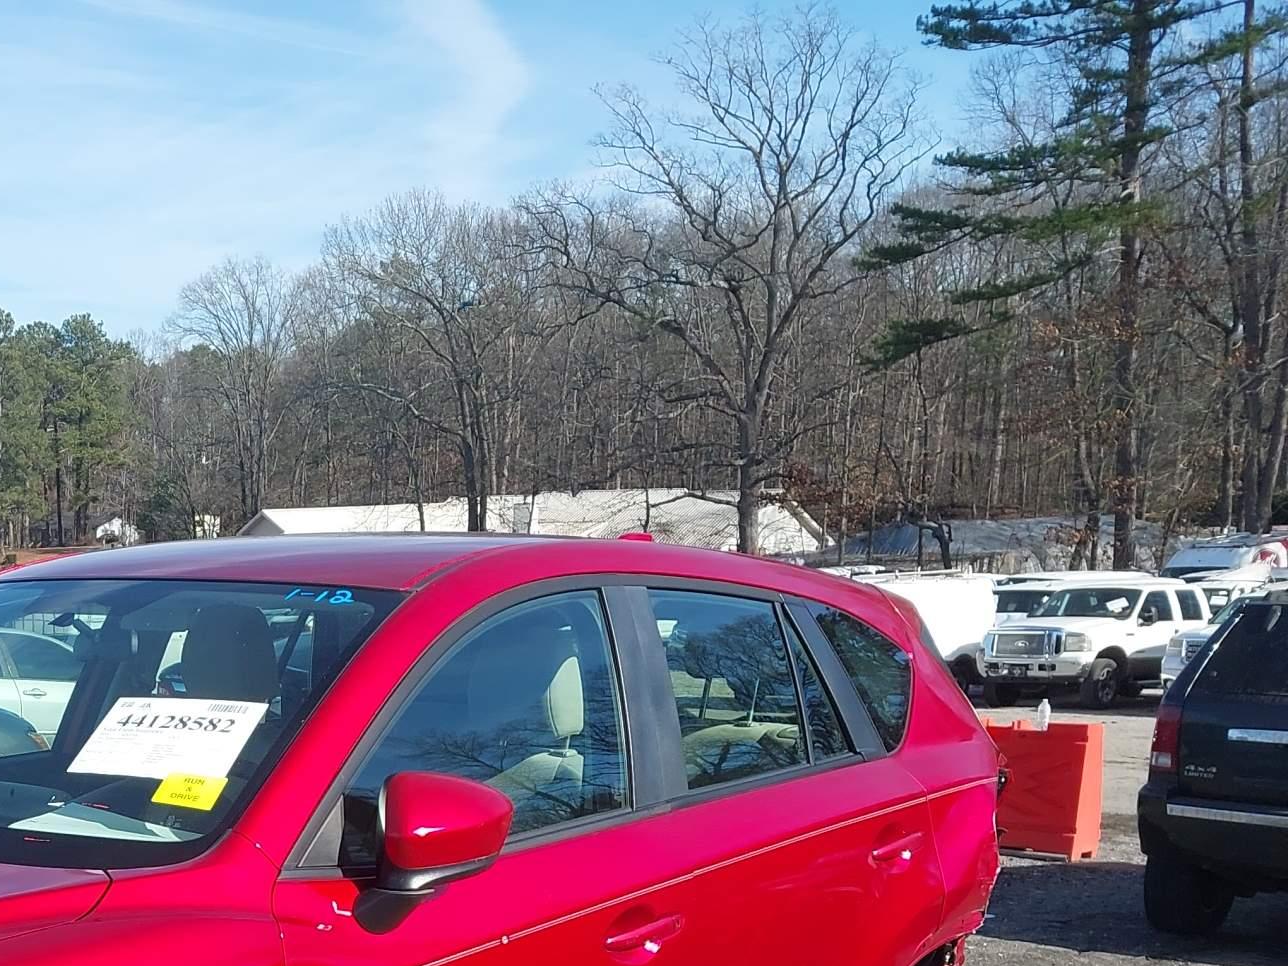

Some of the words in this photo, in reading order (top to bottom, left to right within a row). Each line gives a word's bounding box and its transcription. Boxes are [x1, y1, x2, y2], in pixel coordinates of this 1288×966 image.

[116, 713, 236, 734] 44128582
[183, 777, 206, 786] RUN
[169, 792, 200, 801] DRIVE
